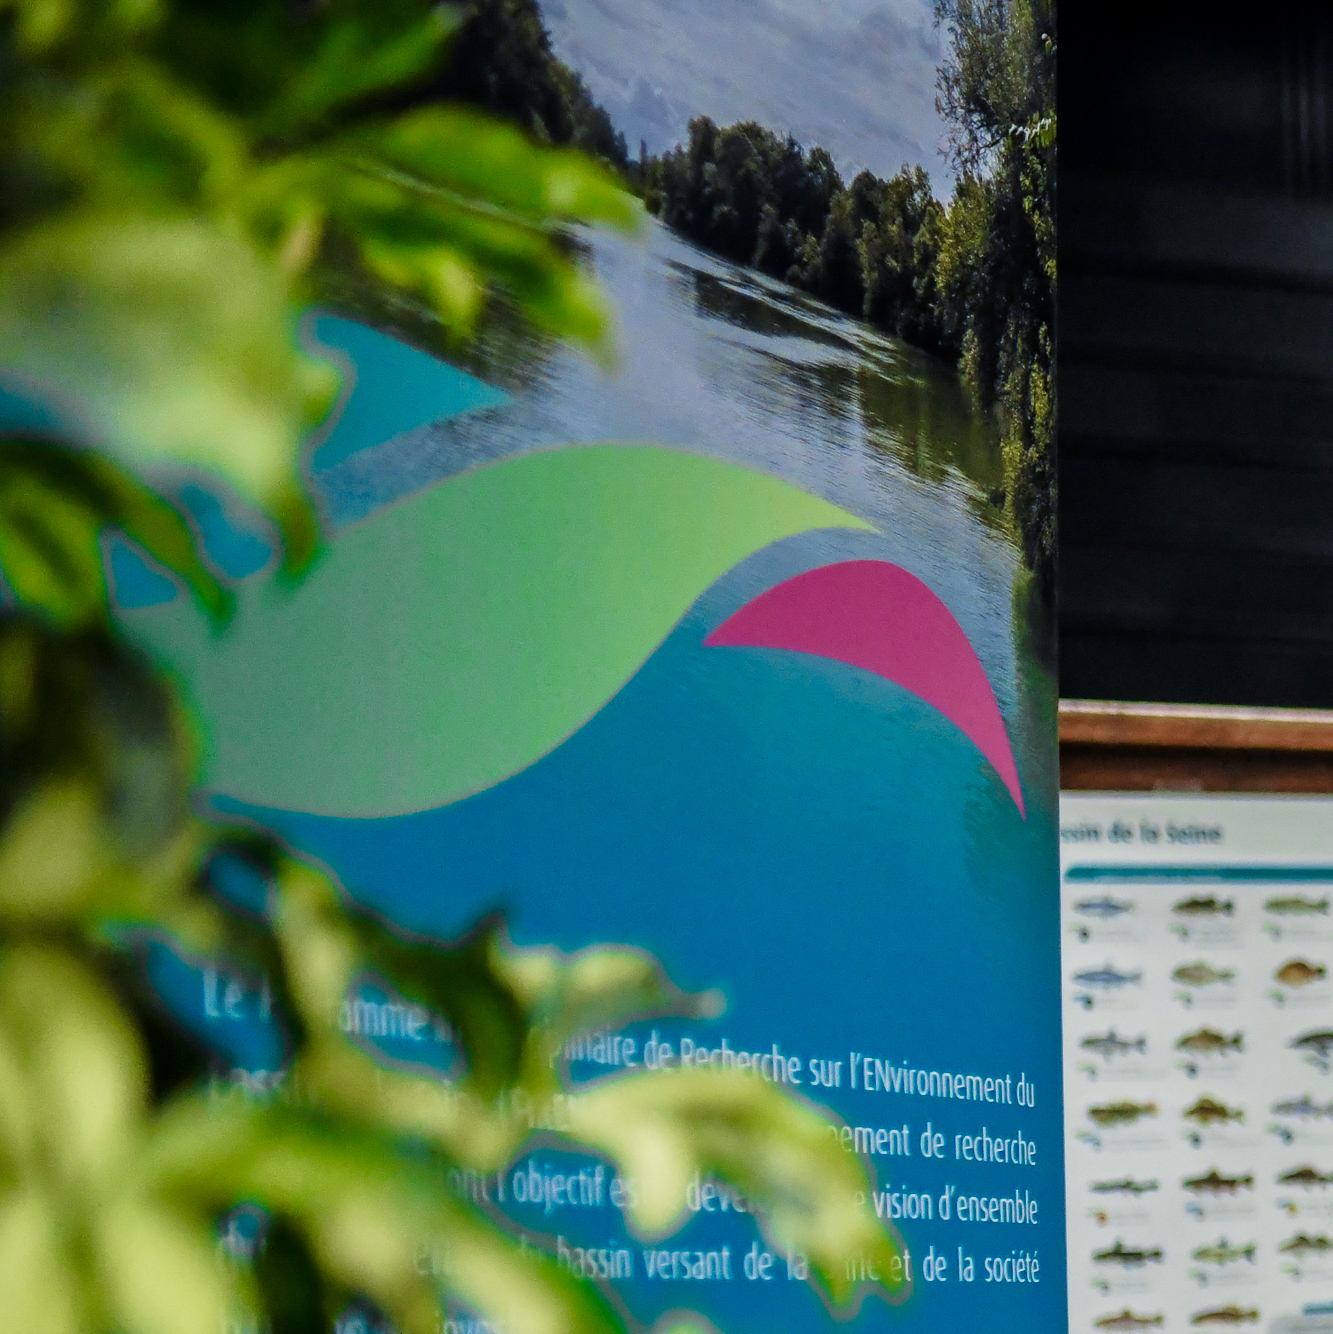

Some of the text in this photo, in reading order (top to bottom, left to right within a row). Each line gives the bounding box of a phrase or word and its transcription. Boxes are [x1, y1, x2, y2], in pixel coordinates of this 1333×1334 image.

[1108, 819, 1133, 844] de
[1165, 821, 1223, 845] Seine
[644, 1029, 673, 1070] de
[810, 1056, 843, 1089] sur
[1016, 1071, 1036, 1109] du
[920, 1121, 1038, 1167] de recherche
[873, 1183, 933, 1221] vision
[643, 1244, 731, 1282] versant
[743, 1240, 775, 1282] de
[786, 1242, 809, 1283] la
[888, 1247, 913, 1283] et
[922, 1243, 948, 1283] de
[957, 1245, 975, 1283] la
[984, 1249, 1042, 1285] société
